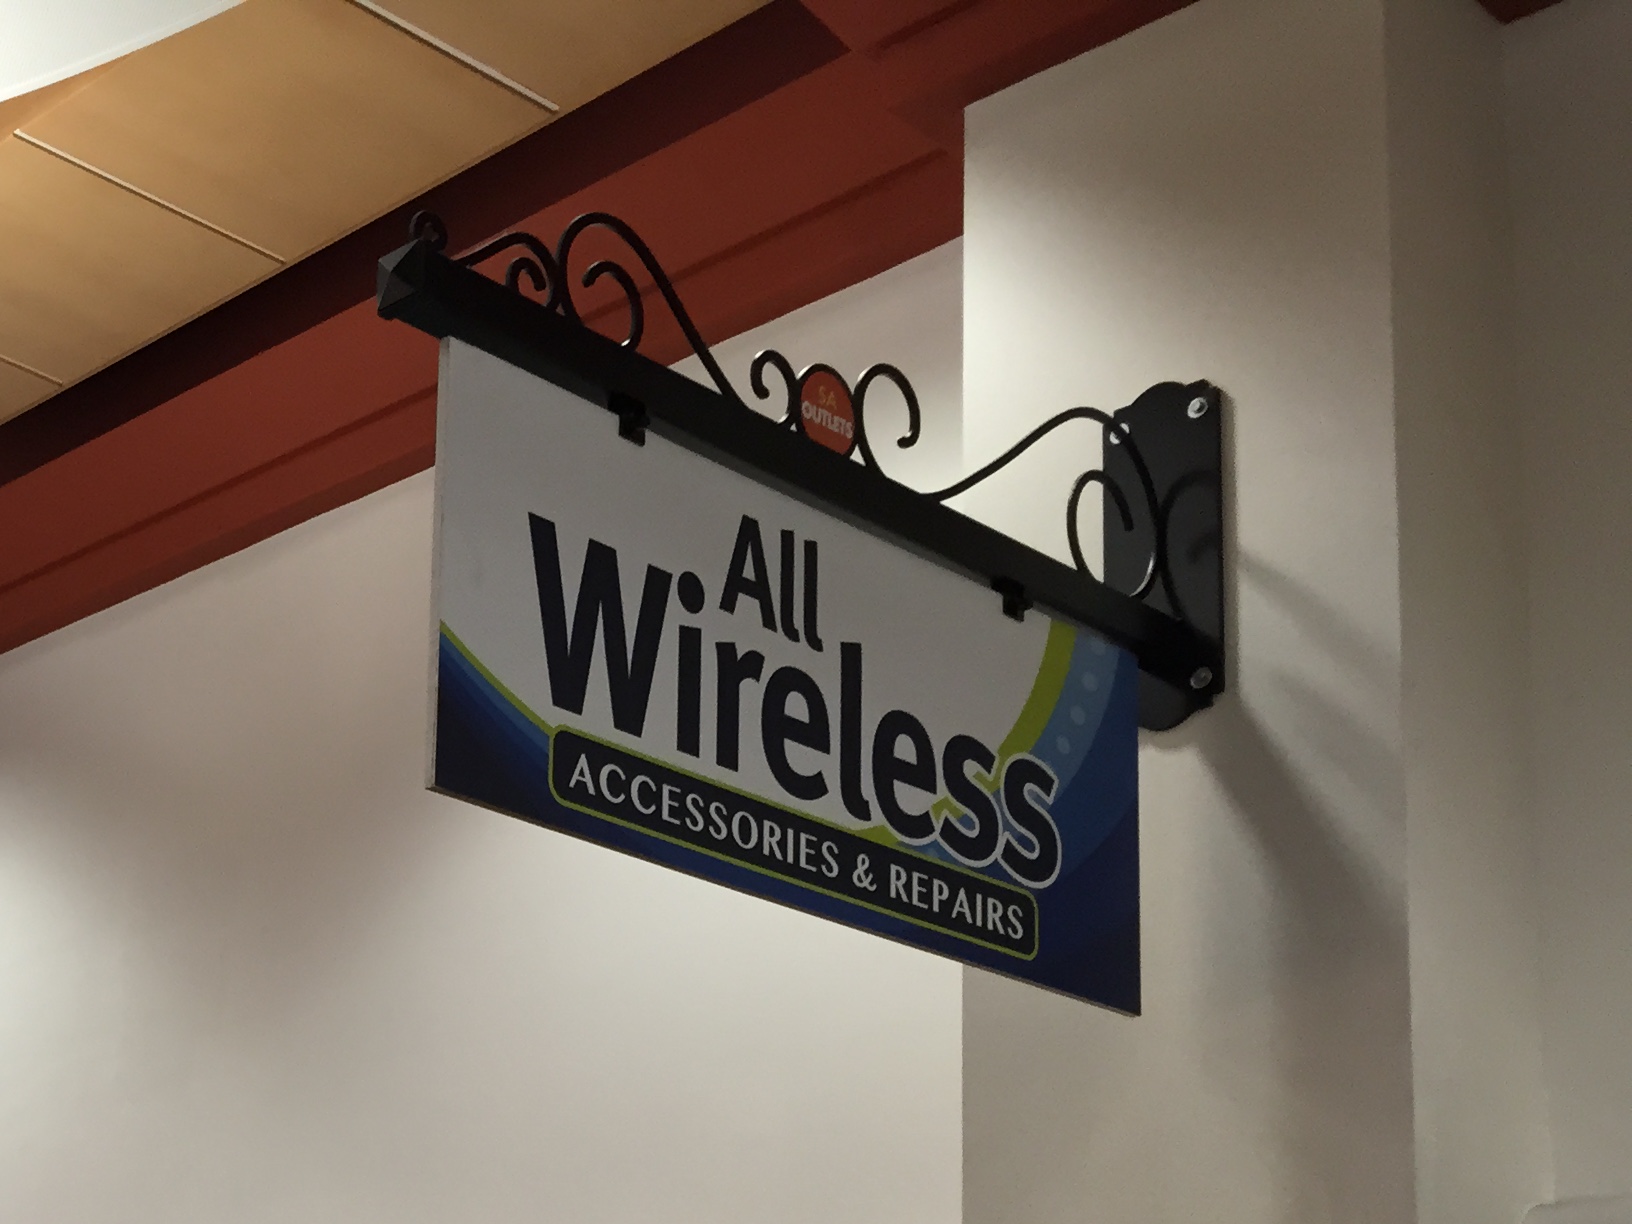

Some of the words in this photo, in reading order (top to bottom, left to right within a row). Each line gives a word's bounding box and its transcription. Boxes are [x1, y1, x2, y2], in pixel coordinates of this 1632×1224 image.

[801, 400, 854, 439] OUTLETS
[719, 514, 824, 652] All
[528, 511, 1062, 889] Wireless
[568, 753, 840, 880] ACCESSORIES
[852, 851, 877, 893] &
[889, 864, 1025, 942] REPAIRS
